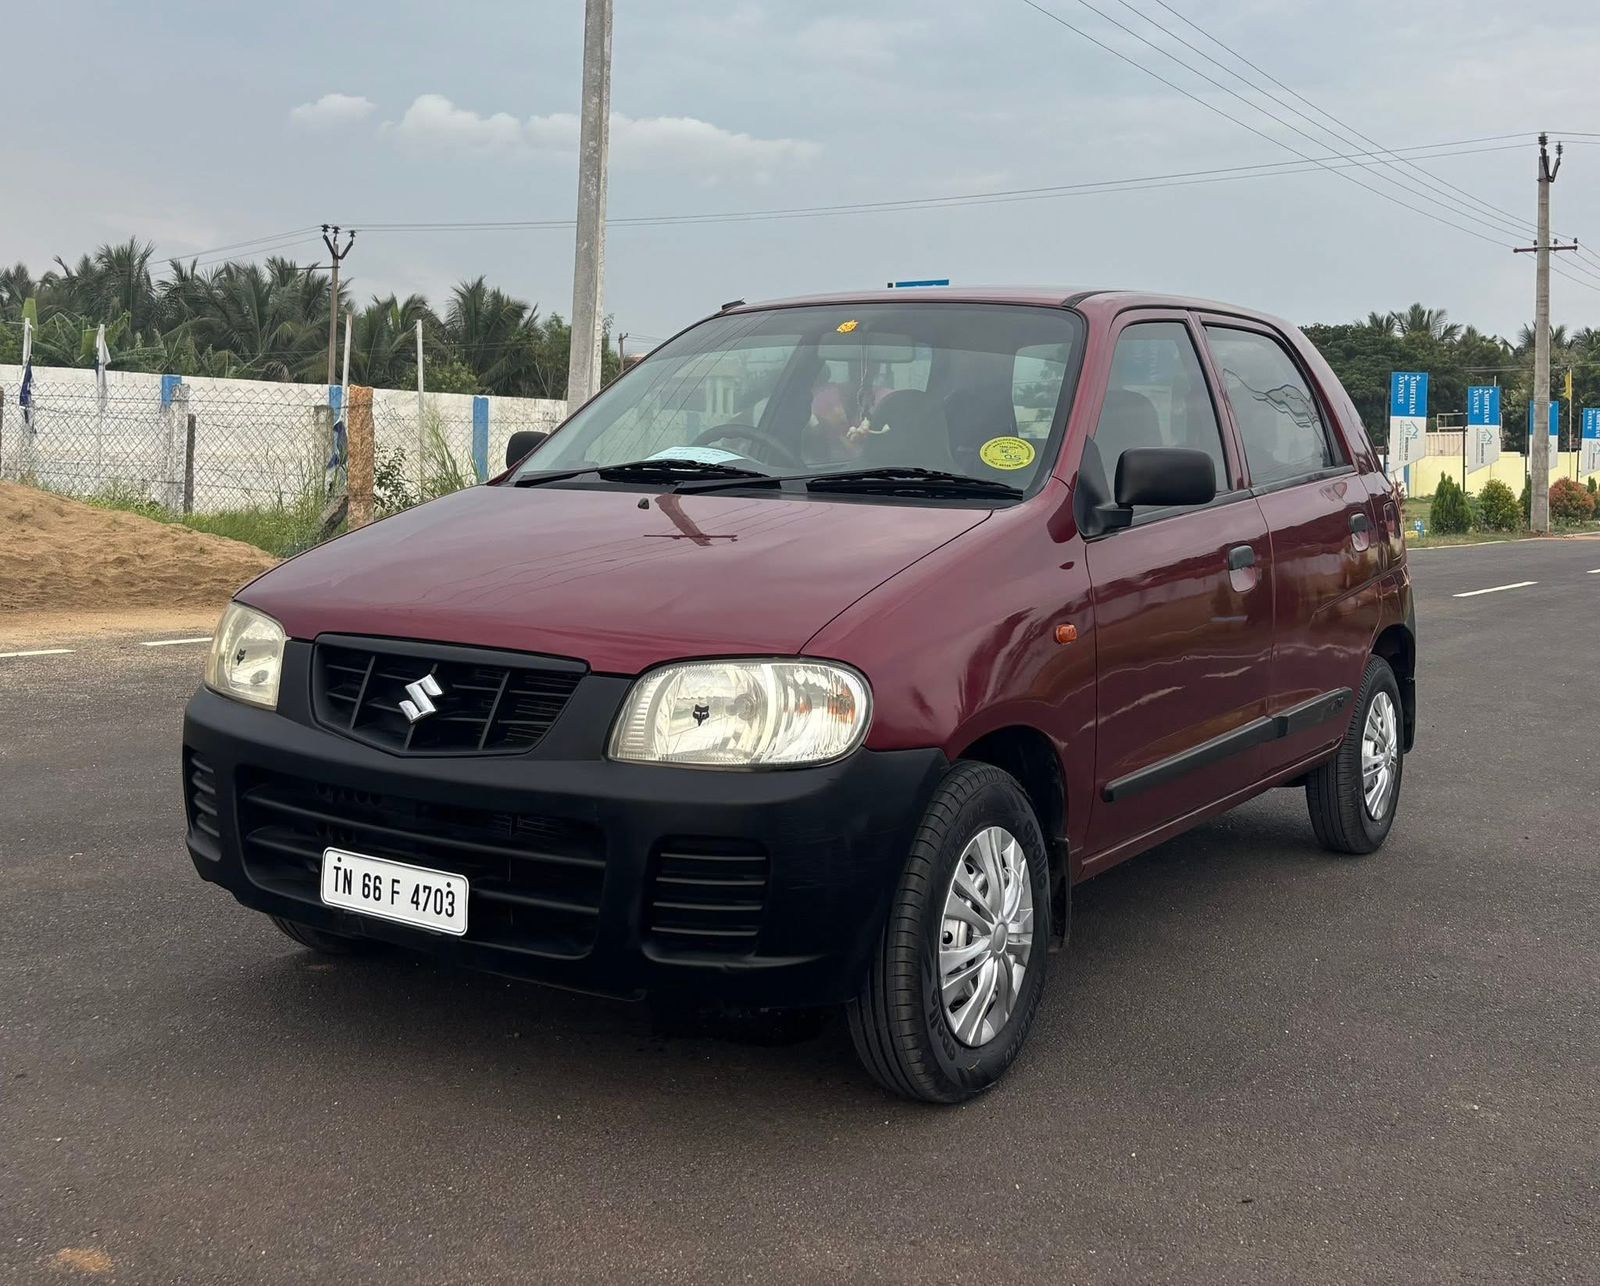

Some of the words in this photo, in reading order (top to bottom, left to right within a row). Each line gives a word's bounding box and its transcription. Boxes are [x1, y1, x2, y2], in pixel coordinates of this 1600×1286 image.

[1023, 819, 1046, 889] apollo
[334, 866, 352, 895] TN
[362, 873, 382, 902] 66
[391, 878, 400, 905] F
[411, 884, 455, 918] 4703
[930, 987, 956, 1060] apollo
